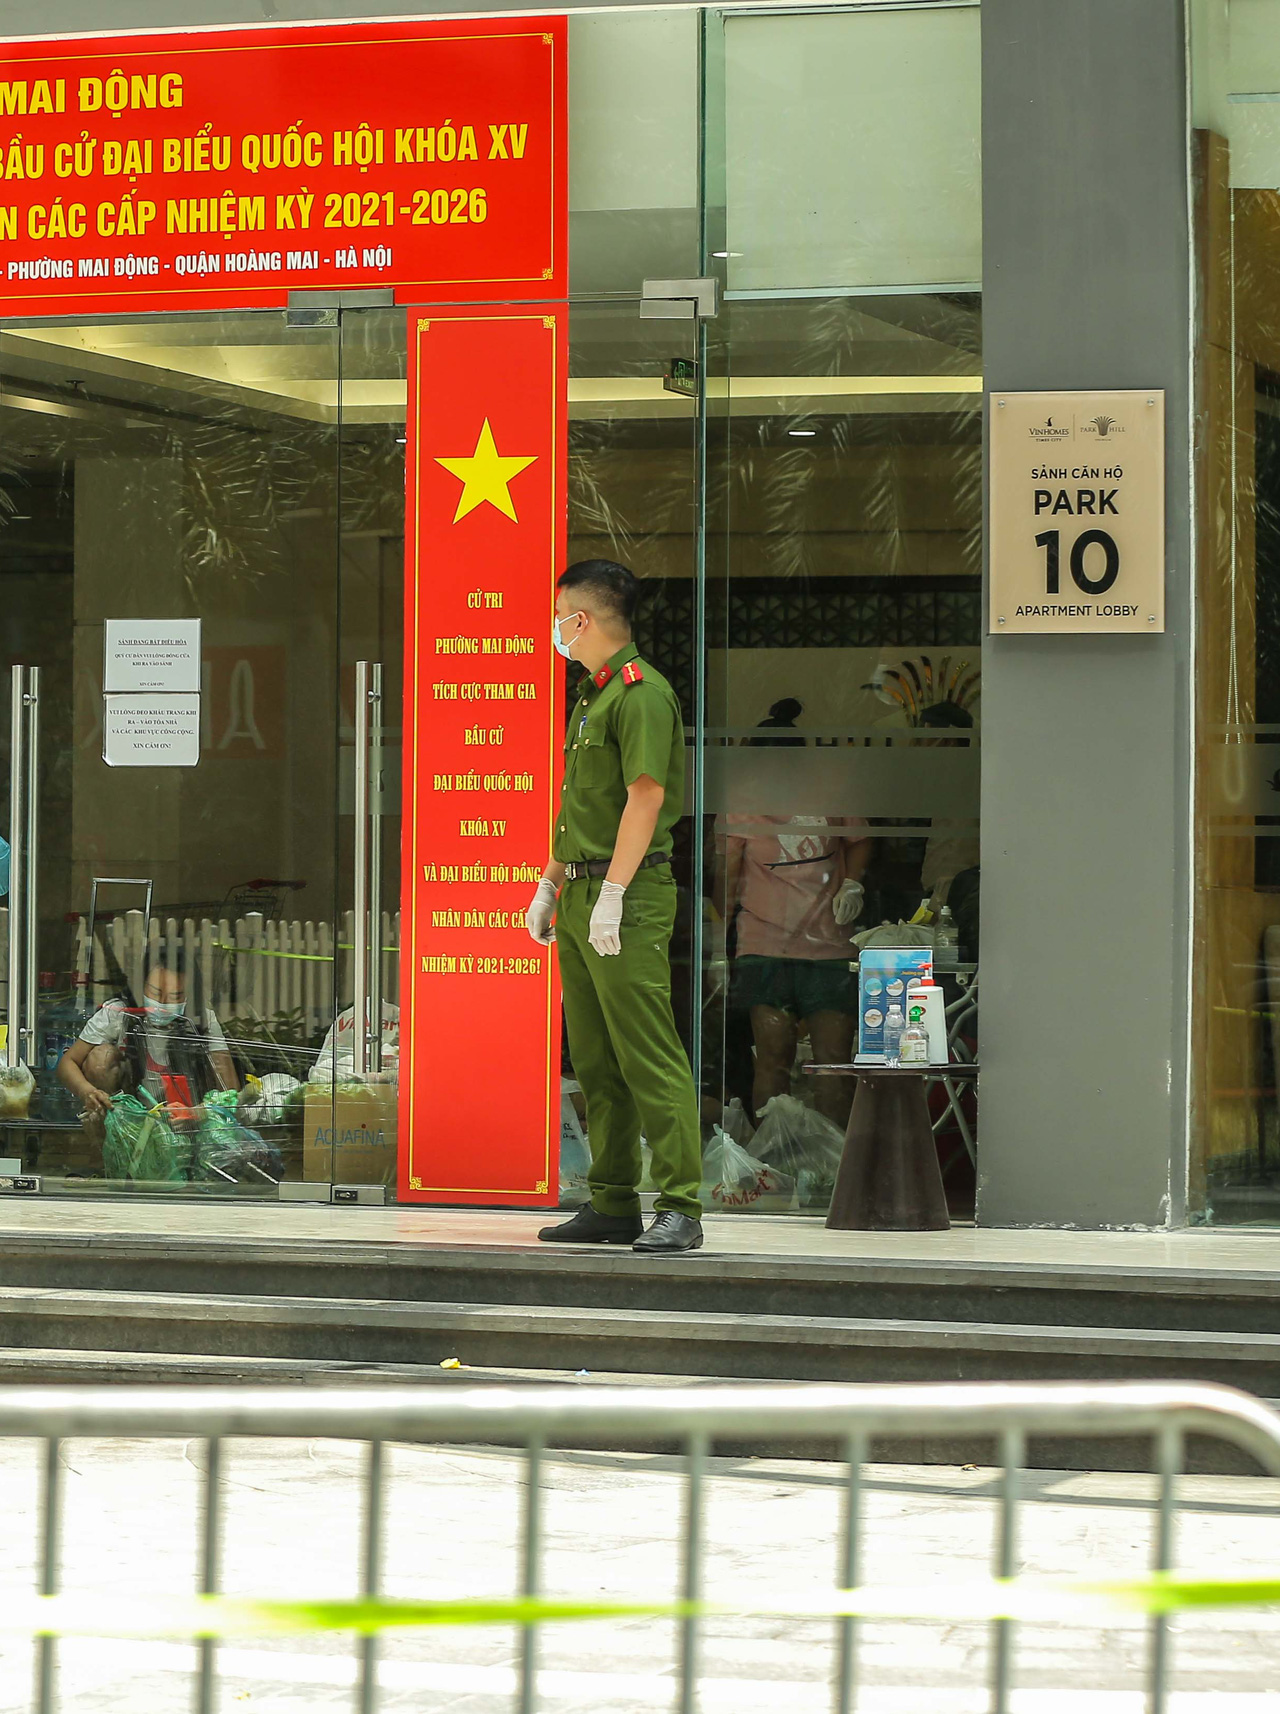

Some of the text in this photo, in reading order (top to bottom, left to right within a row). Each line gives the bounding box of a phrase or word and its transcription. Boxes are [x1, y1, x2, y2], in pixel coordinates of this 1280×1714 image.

[77, 68, 183, 118] ĐỘNG
[54, 130, 97, 178] CỬ
[102, 139, 153, 183] ĐẠI
[163, 122, 231, 173] BIỂU
[241, 119, 323, 174] QUỐC
[333, 122, 384, 173] HỘI
[395, 118, 479, 164] KHÓA
[487, 123, 529, 160] XV
[27, 196, 87, 240] CÁC
[96, 188, 157, 237] CẤP
[166, 189, 265, 240] NHIỆM
[276, 186, 315, 230] KỲ
[323, 187, 487, 228] 2021-2026
[7, 256, 74, 280] PHƯỜNG
[78, 258, 110, 278] MAI
[113, 253, 159, 280] ĐỘNG
[175, 250, 220, 278] QUẬN
[225, 248, 282, 272] HOÀNG
[286, 250, 319, 270] MAI
[335, 245, 358, 269] HÀ
[362, 244, 392, 271] NỘI
[1029, 427, 1070, 436] VINHOMES
[1031, 464, 1123, 481] SẢNH CĂN HỘ
[1034, 489, 1119, 515] PARK
[1034, 529, 1120, 595] 10
[467, 587, 503, 609] CỬ TRI
[1015, 605, 1139, 617] APARTMENT LOBBY
[435, 634, 535, 657] PHƯỜNG MAI ĐỘNG
[432, 679, 537, 703] TÍCH CỰC THAM GIA
[464, 723, 505, 746] BẦU CỬ
[433, 768, 534, 794] ĐẠI BIỂU QUỐC HỘI
[459, 816, 507, 837] KHÓA XV
[423, 859, 542, 885] VÀ ĐẠI BIỂU HỘI ĐỒNG
[431, 906, 529, 929] NHÂN DÂN CÁC CẤ
[421, 953, 541, 976] NHIỆM KỲ 2021-2026!
[313, 1125, 386, 1149] AQUAFINA
[711, 1169, 771, 1206] VnMart+
